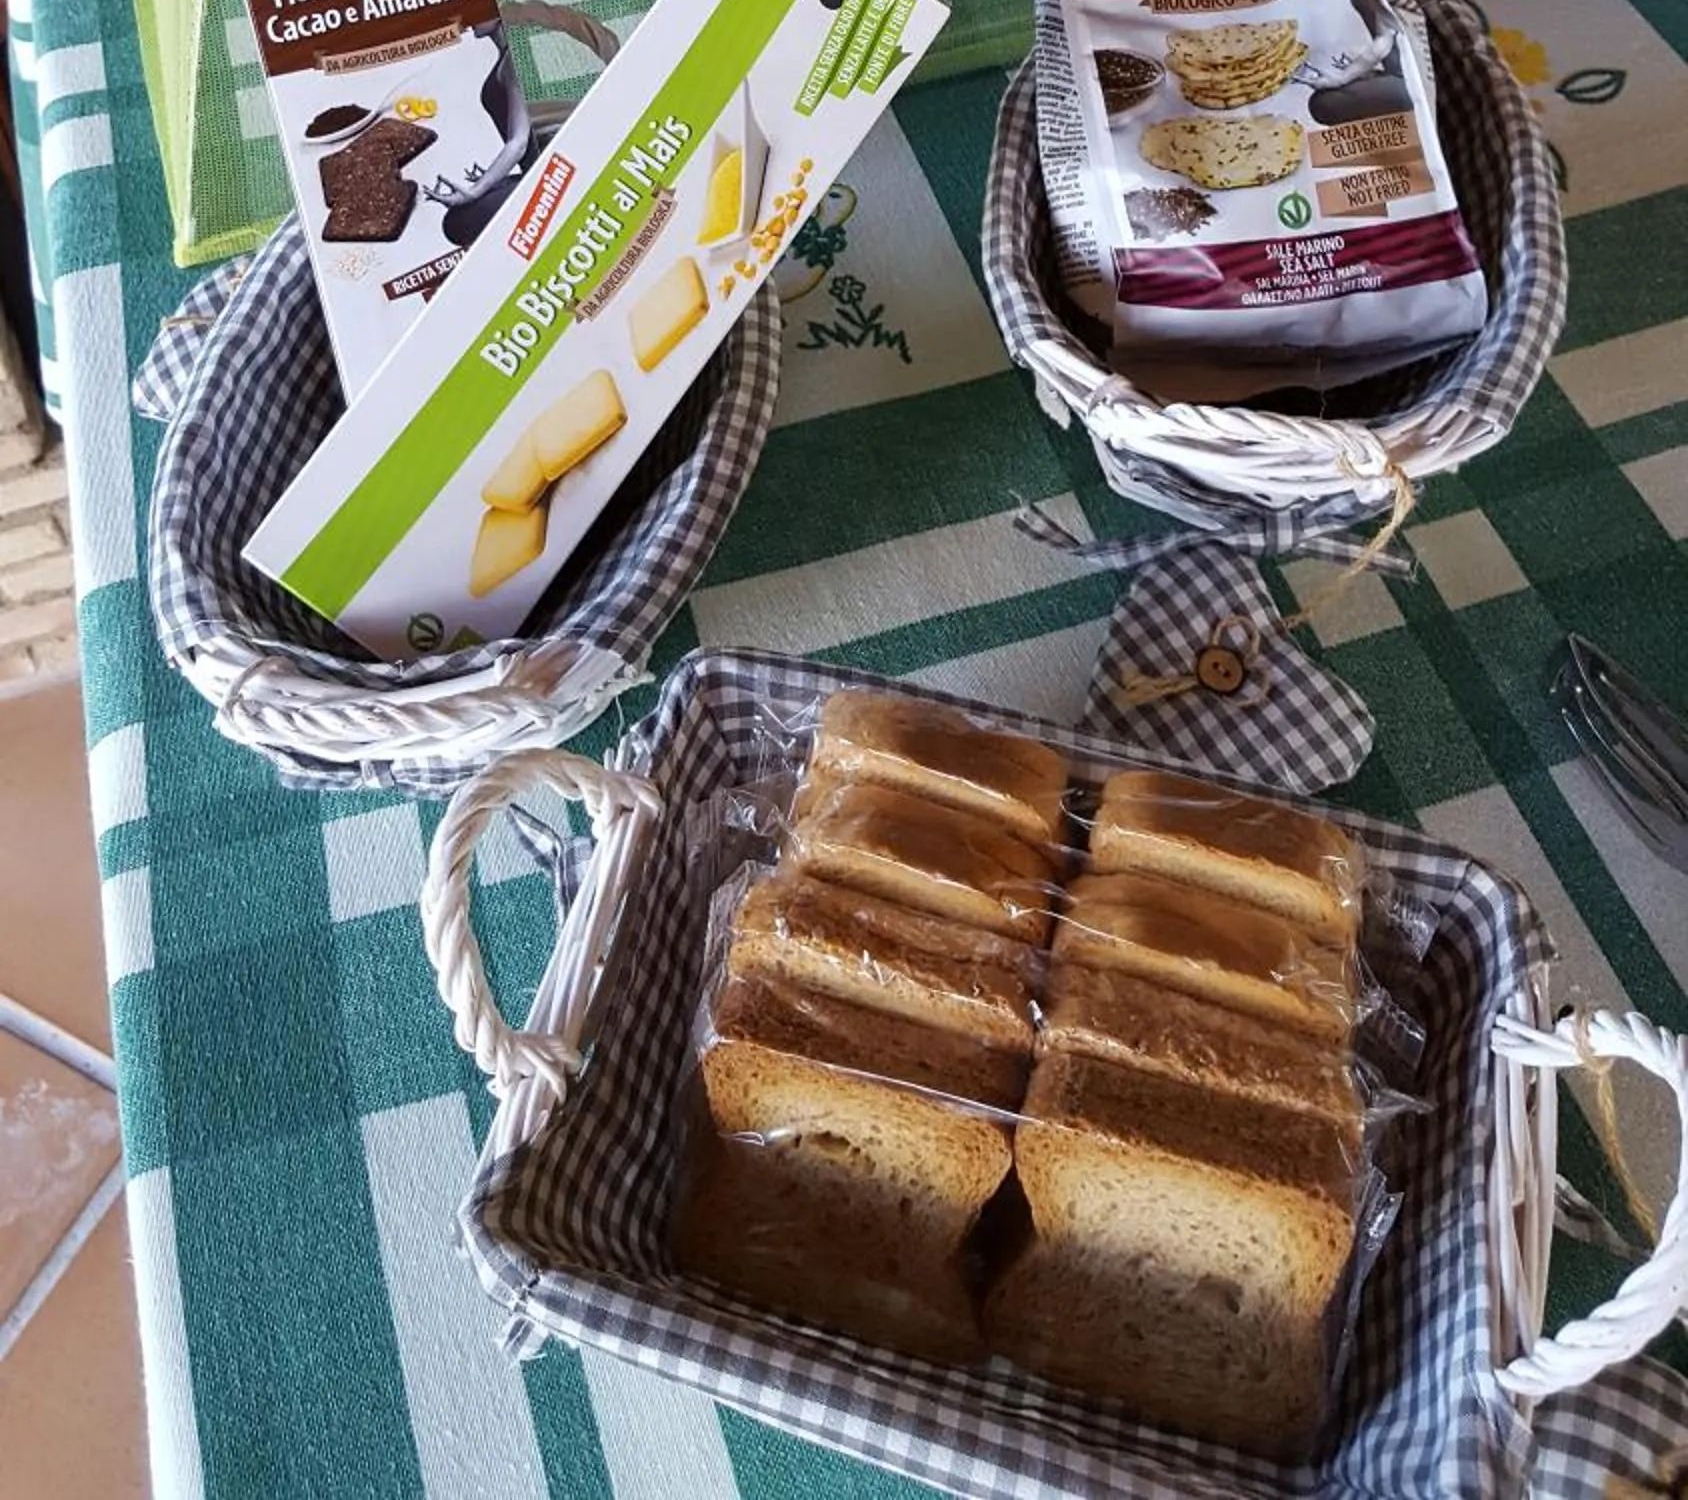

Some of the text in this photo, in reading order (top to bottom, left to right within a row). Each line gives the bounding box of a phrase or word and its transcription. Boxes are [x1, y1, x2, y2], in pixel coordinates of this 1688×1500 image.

[266, 8, 341, 43] Cacao
[345, 6, 359, 23] e
[511, 157, 571, 258] Fiorentini
[480, 115, 692, 378] Bio Biscotti al Mais
[1265, 242, 1294, 260] SALE
[1280, 254, 1334, 274] SEA SALT
